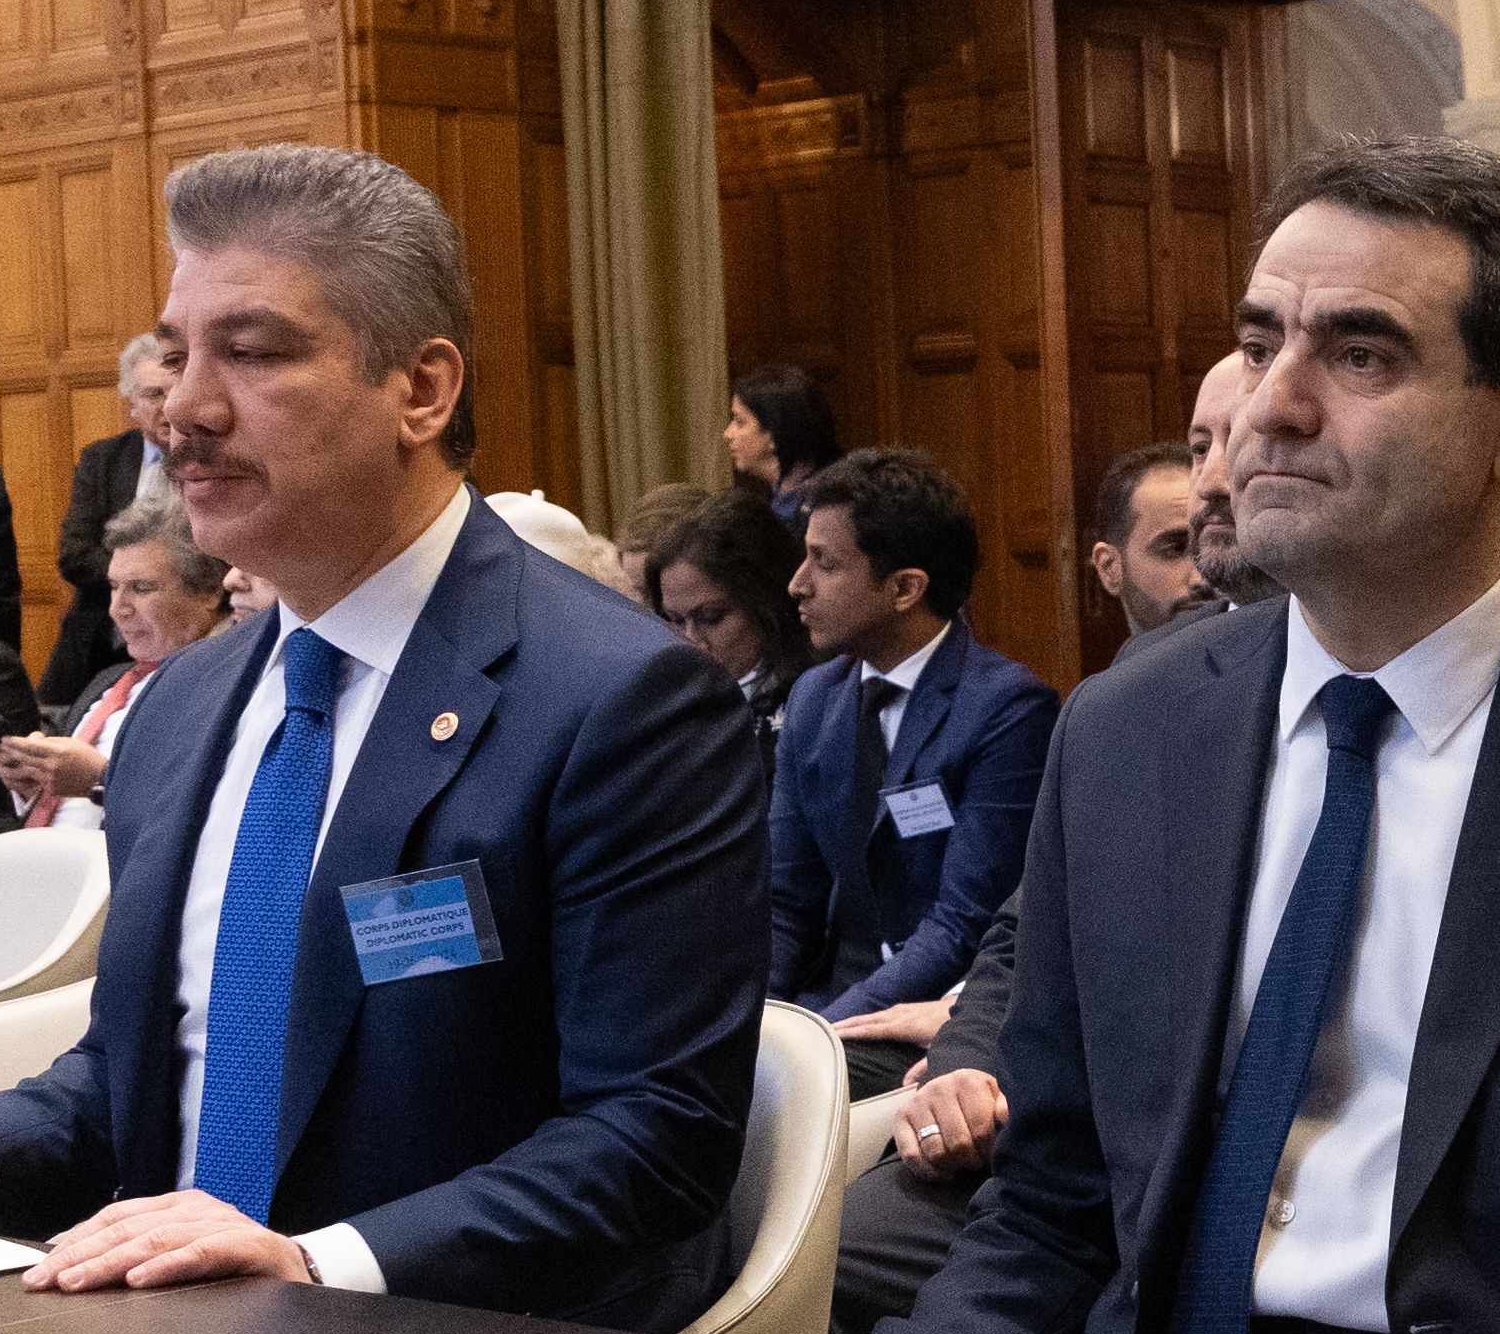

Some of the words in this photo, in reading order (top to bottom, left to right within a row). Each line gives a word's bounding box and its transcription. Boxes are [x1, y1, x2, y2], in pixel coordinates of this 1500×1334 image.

[356, 921, 390, 936] CORPS
[392, 907, 469, 930] DIPLOMATIQUE
[367, 928, 429, 947] DIPLOMATIC
[431, 921, 464, 935] CORPS
